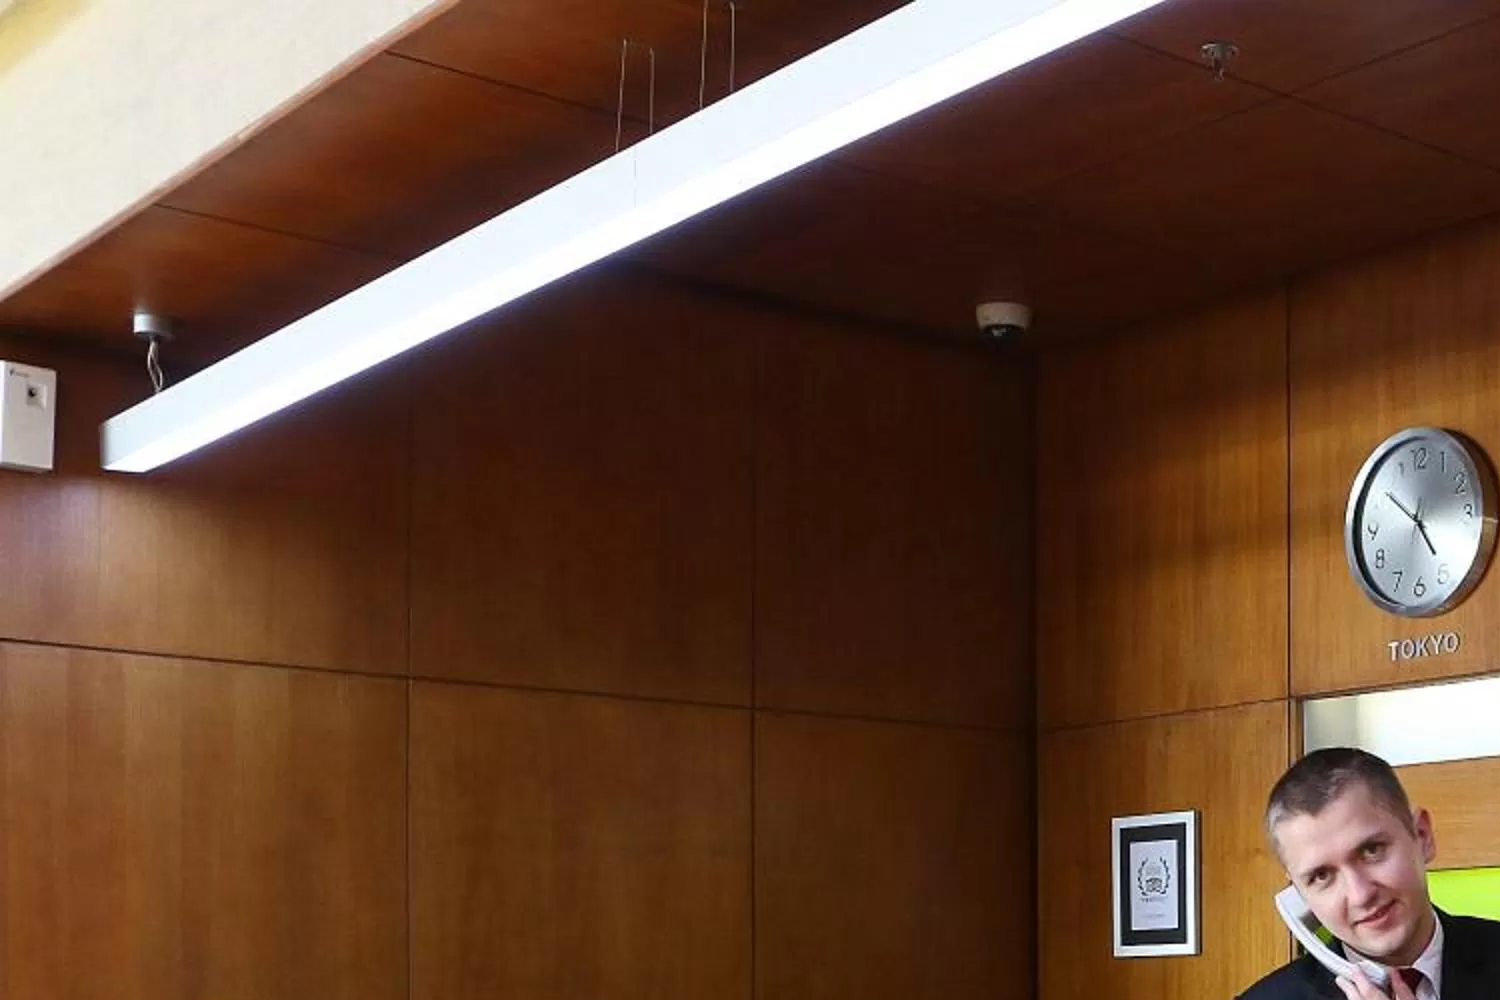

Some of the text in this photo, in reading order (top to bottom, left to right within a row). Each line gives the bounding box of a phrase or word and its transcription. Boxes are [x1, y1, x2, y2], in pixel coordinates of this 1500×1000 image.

[1375, 549, 1385, 569] 8
[1392, 571, 1402, 593] 7
[1437, 564, 1450, 585] 5
[1414, 576, 1427, 597] 6
[1388, 633, 1461, 661] TOKYO
